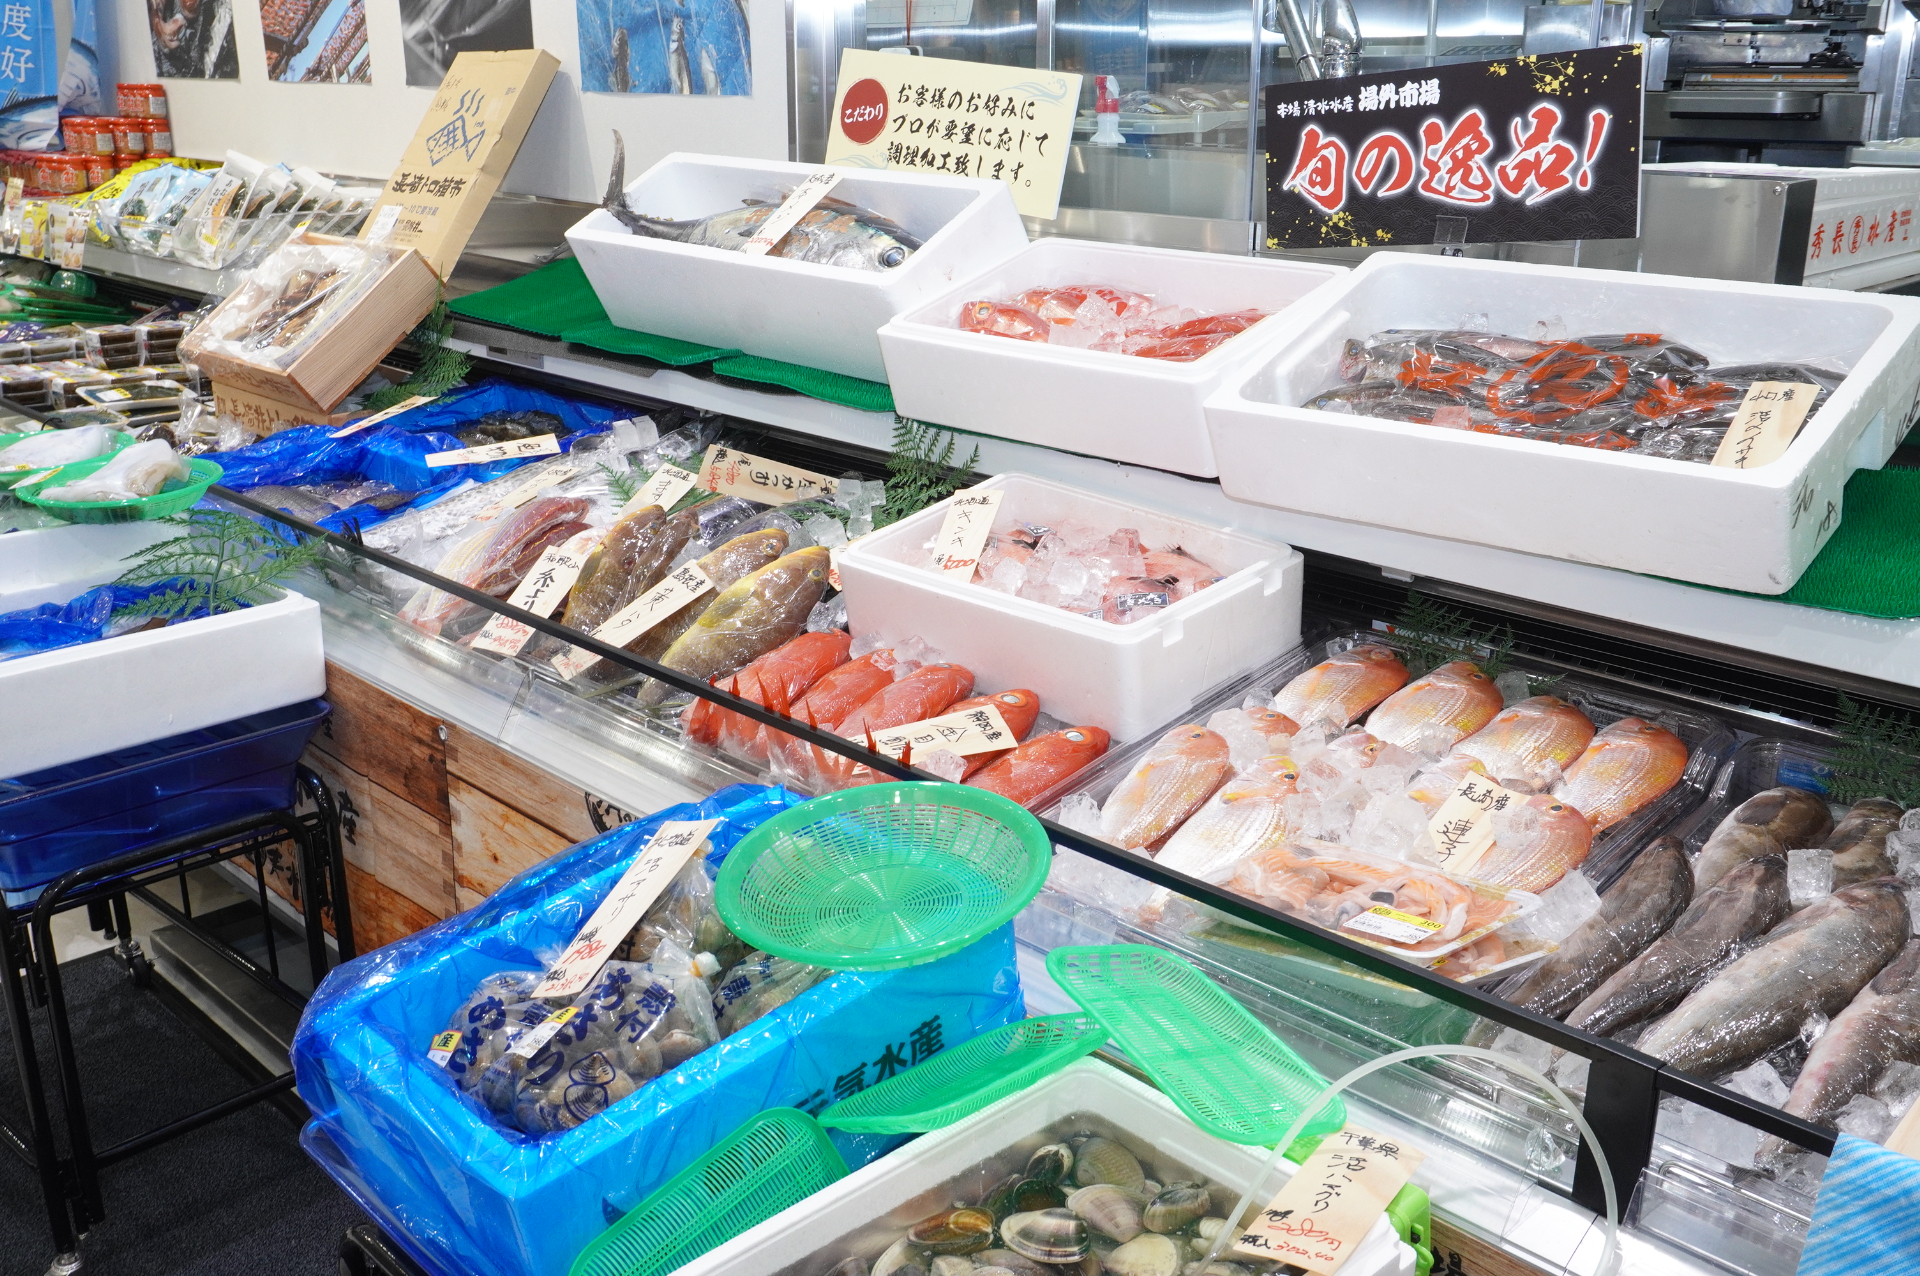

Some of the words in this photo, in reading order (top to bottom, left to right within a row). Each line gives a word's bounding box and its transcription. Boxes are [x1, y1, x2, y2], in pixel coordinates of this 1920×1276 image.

[843, 102, 884, 124] こだわり
[897, 83, 1036, 121] お客様のお好みに
[1276, 101, 1300, 119] 本場
[1303, 95, 1355, 116] 清水水産
[1358, 78, 1441, 112] 場外市場
[892, 114, 1049, 158] プロが要望に応じて
[886, 141, 1032, 188] 調理加工致します。
[1283, 102, 1610, 213] 旬の逸品!
[950, 509, 973, 548] キンキ
[671, 566, 706, 594] 島根産
[561, 939, 608, 965] 1980
